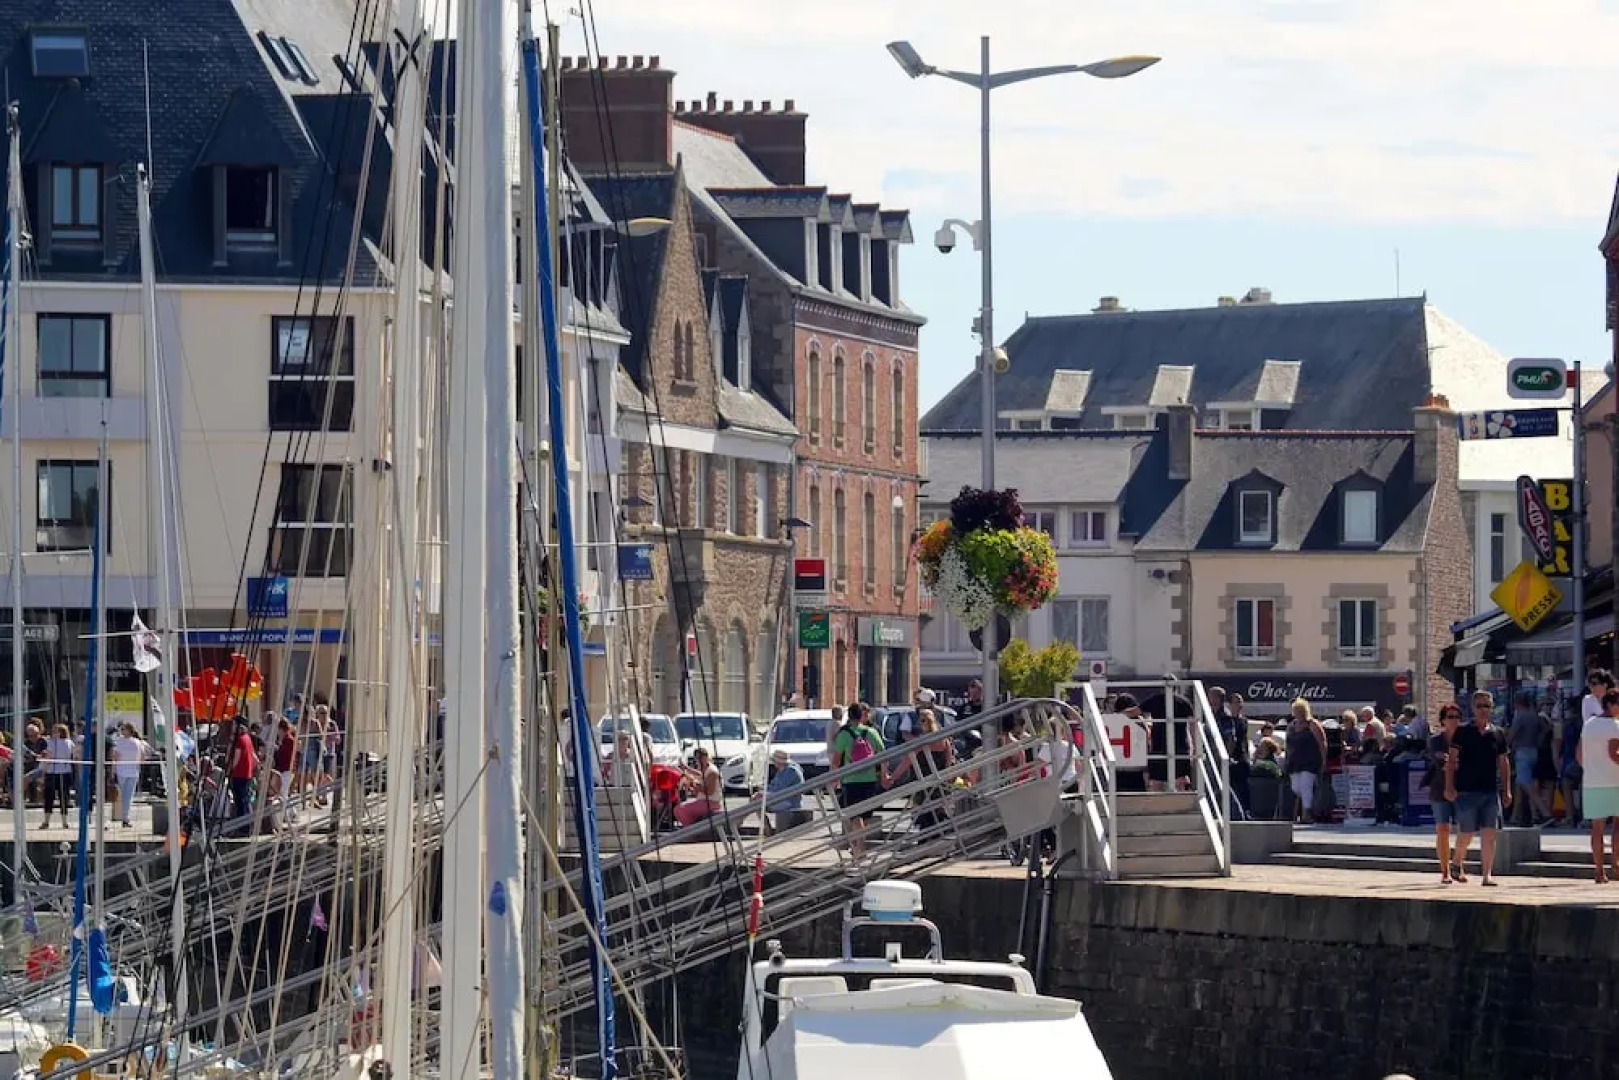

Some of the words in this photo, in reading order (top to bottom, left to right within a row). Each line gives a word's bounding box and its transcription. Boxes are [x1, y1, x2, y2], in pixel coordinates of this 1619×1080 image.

[1517, 374, 1541, 385] PMU
[1523, 487, 1551, 554] TABAC
[261, 634, 315, 642] POPUAIRE
